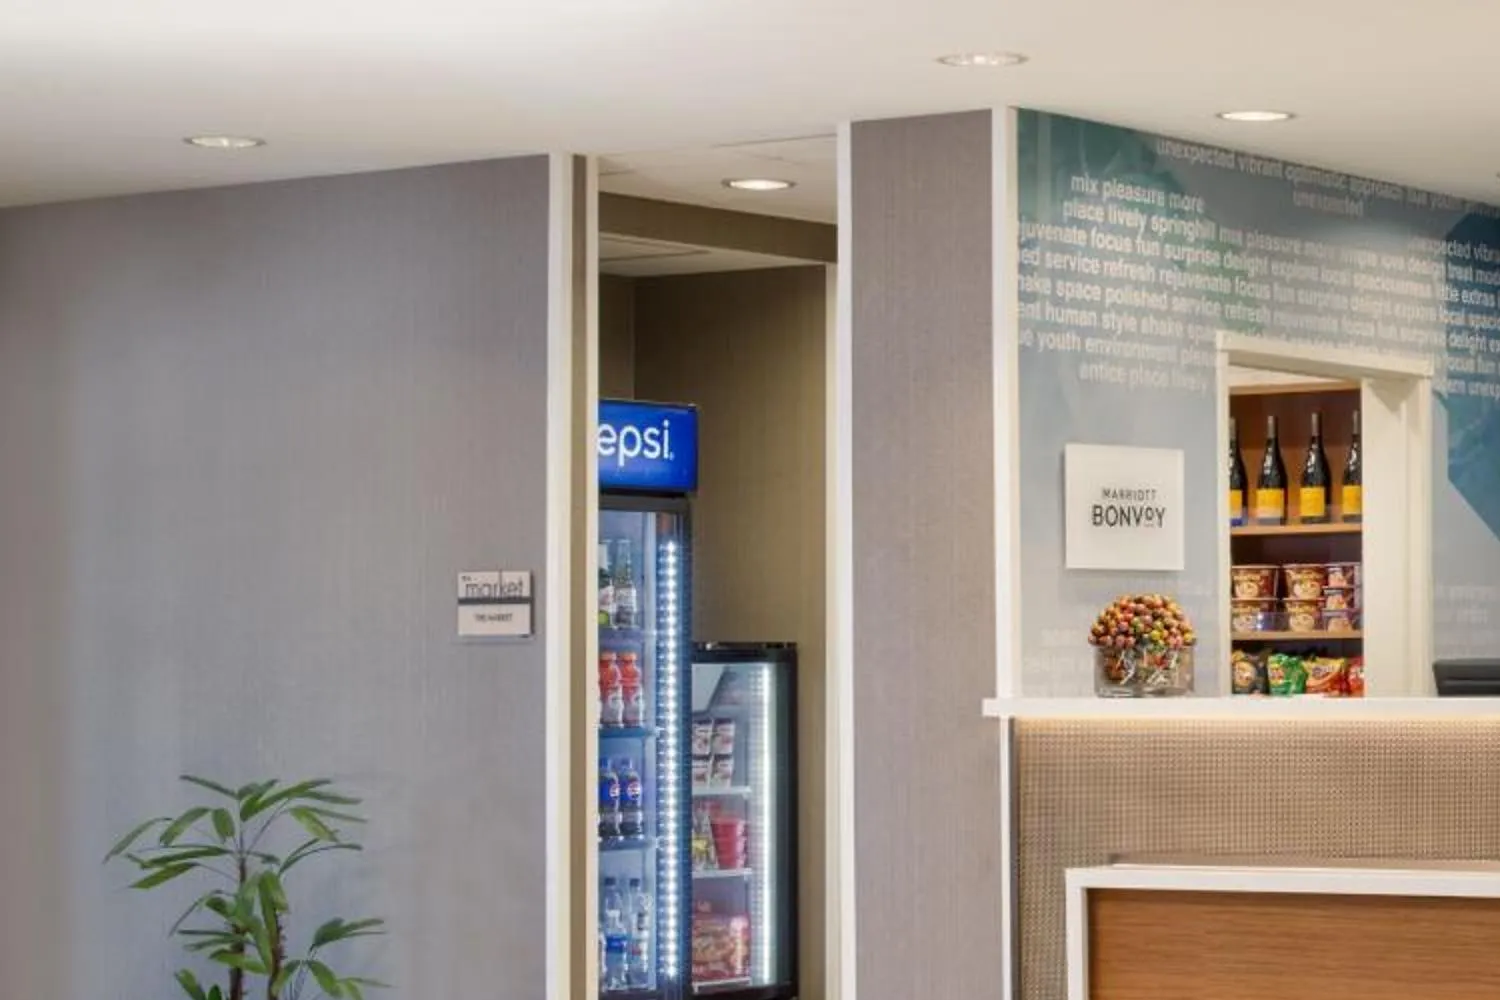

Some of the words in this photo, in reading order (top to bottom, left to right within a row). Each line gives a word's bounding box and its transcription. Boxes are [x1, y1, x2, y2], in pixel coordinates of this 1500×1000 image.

[1071, 174, 1098, 193] mix
[1102, 179, 1165, 206] pleasure
[1169, 192, 1205, 213] more
[1063, 200, 1104, 222] place
[1108, 203, 1147, 235] lively
[1045, 251, 1100, 275] service
[1104, 258, 1155, 280] refresh
[1164, 244, 1220, 268] surprise
[1056, 280, 1100, 302] space
[1105, 285, 1167, 310] polished
[1045, 302, 1097, 327] human
[1038, 330, 1081, 352] youth
[598, 419, 670, 467] epsi
[1092, 504, 1166, 528] BONVOY
